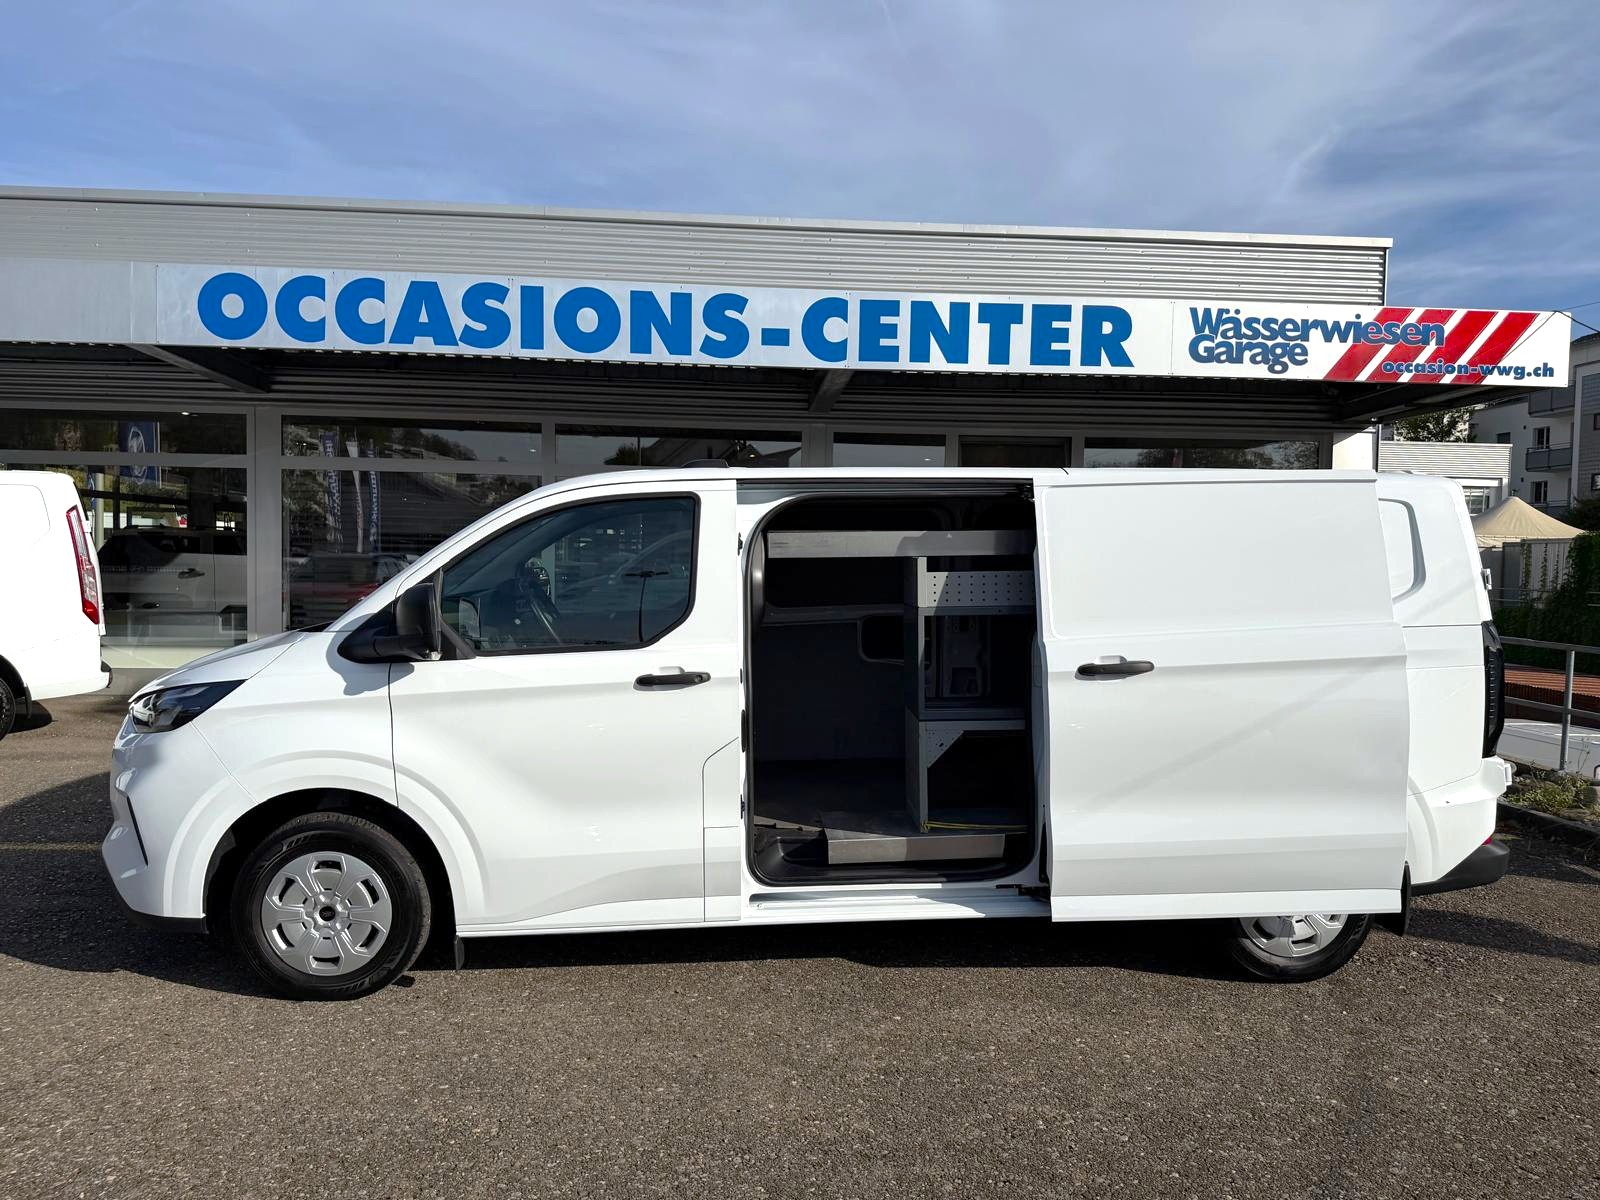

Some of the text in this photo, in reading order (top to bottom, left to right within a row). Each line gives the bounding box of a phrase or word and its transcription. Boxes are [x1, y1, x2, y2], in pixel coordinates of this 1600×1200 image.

[196, 271, 1133, 367] OCCASIONS-CENTER
[1189, 307, 1445, 347] Wässerwiesen
[1188, 333, 1309, 374] Garage
[1382, 359, 1555, 380] occasion-wwg.ch
